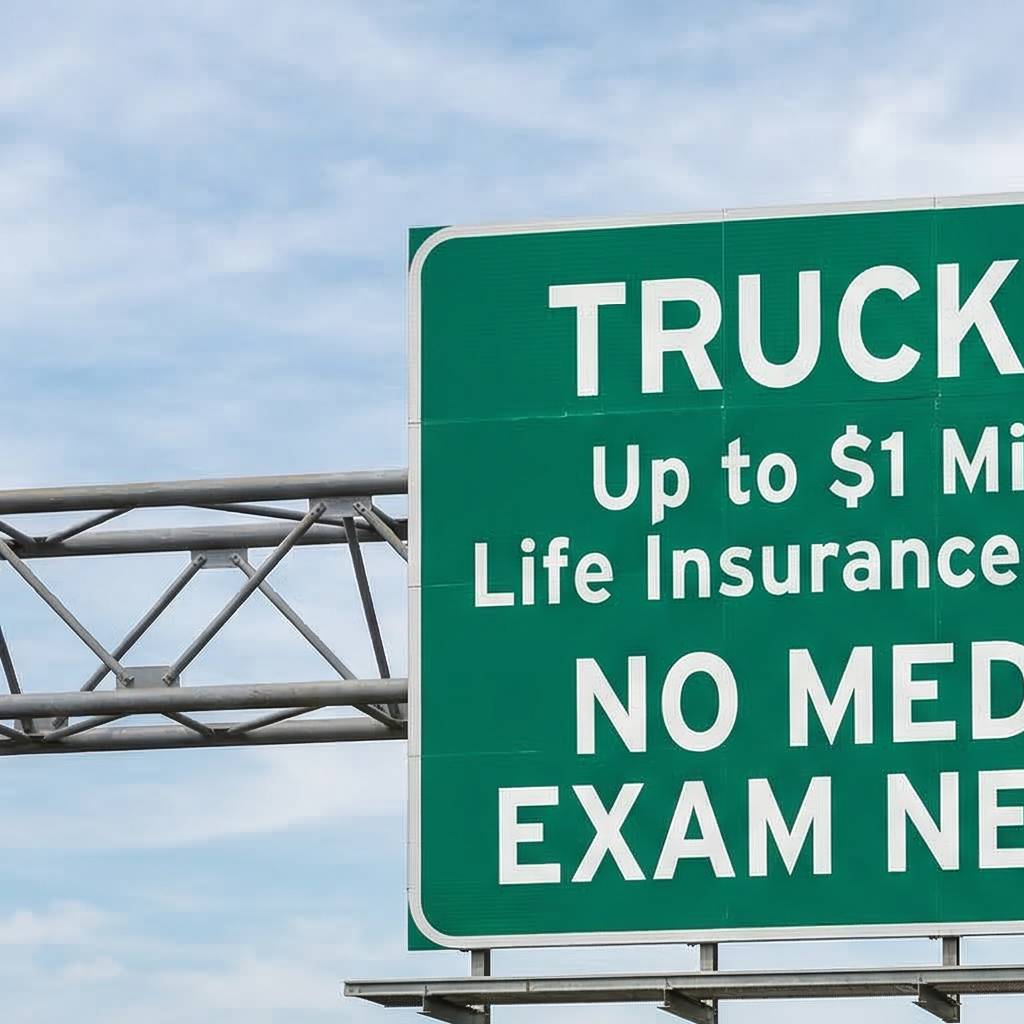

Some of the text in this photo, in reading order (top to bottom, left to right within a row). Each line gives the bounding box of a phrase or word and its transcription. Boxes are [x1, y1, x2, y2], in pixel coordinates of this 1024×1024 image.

[593, 444, 690, 525] Up
[721, 437, 798, 505] to
[829, 424, 904, 508] $1
[474, 534, 614, 608] Life
[647, 534, 1020, 600] Insurance
[576, 651, 738, 755] NO
[498, 776, 832, 885] EXAM
